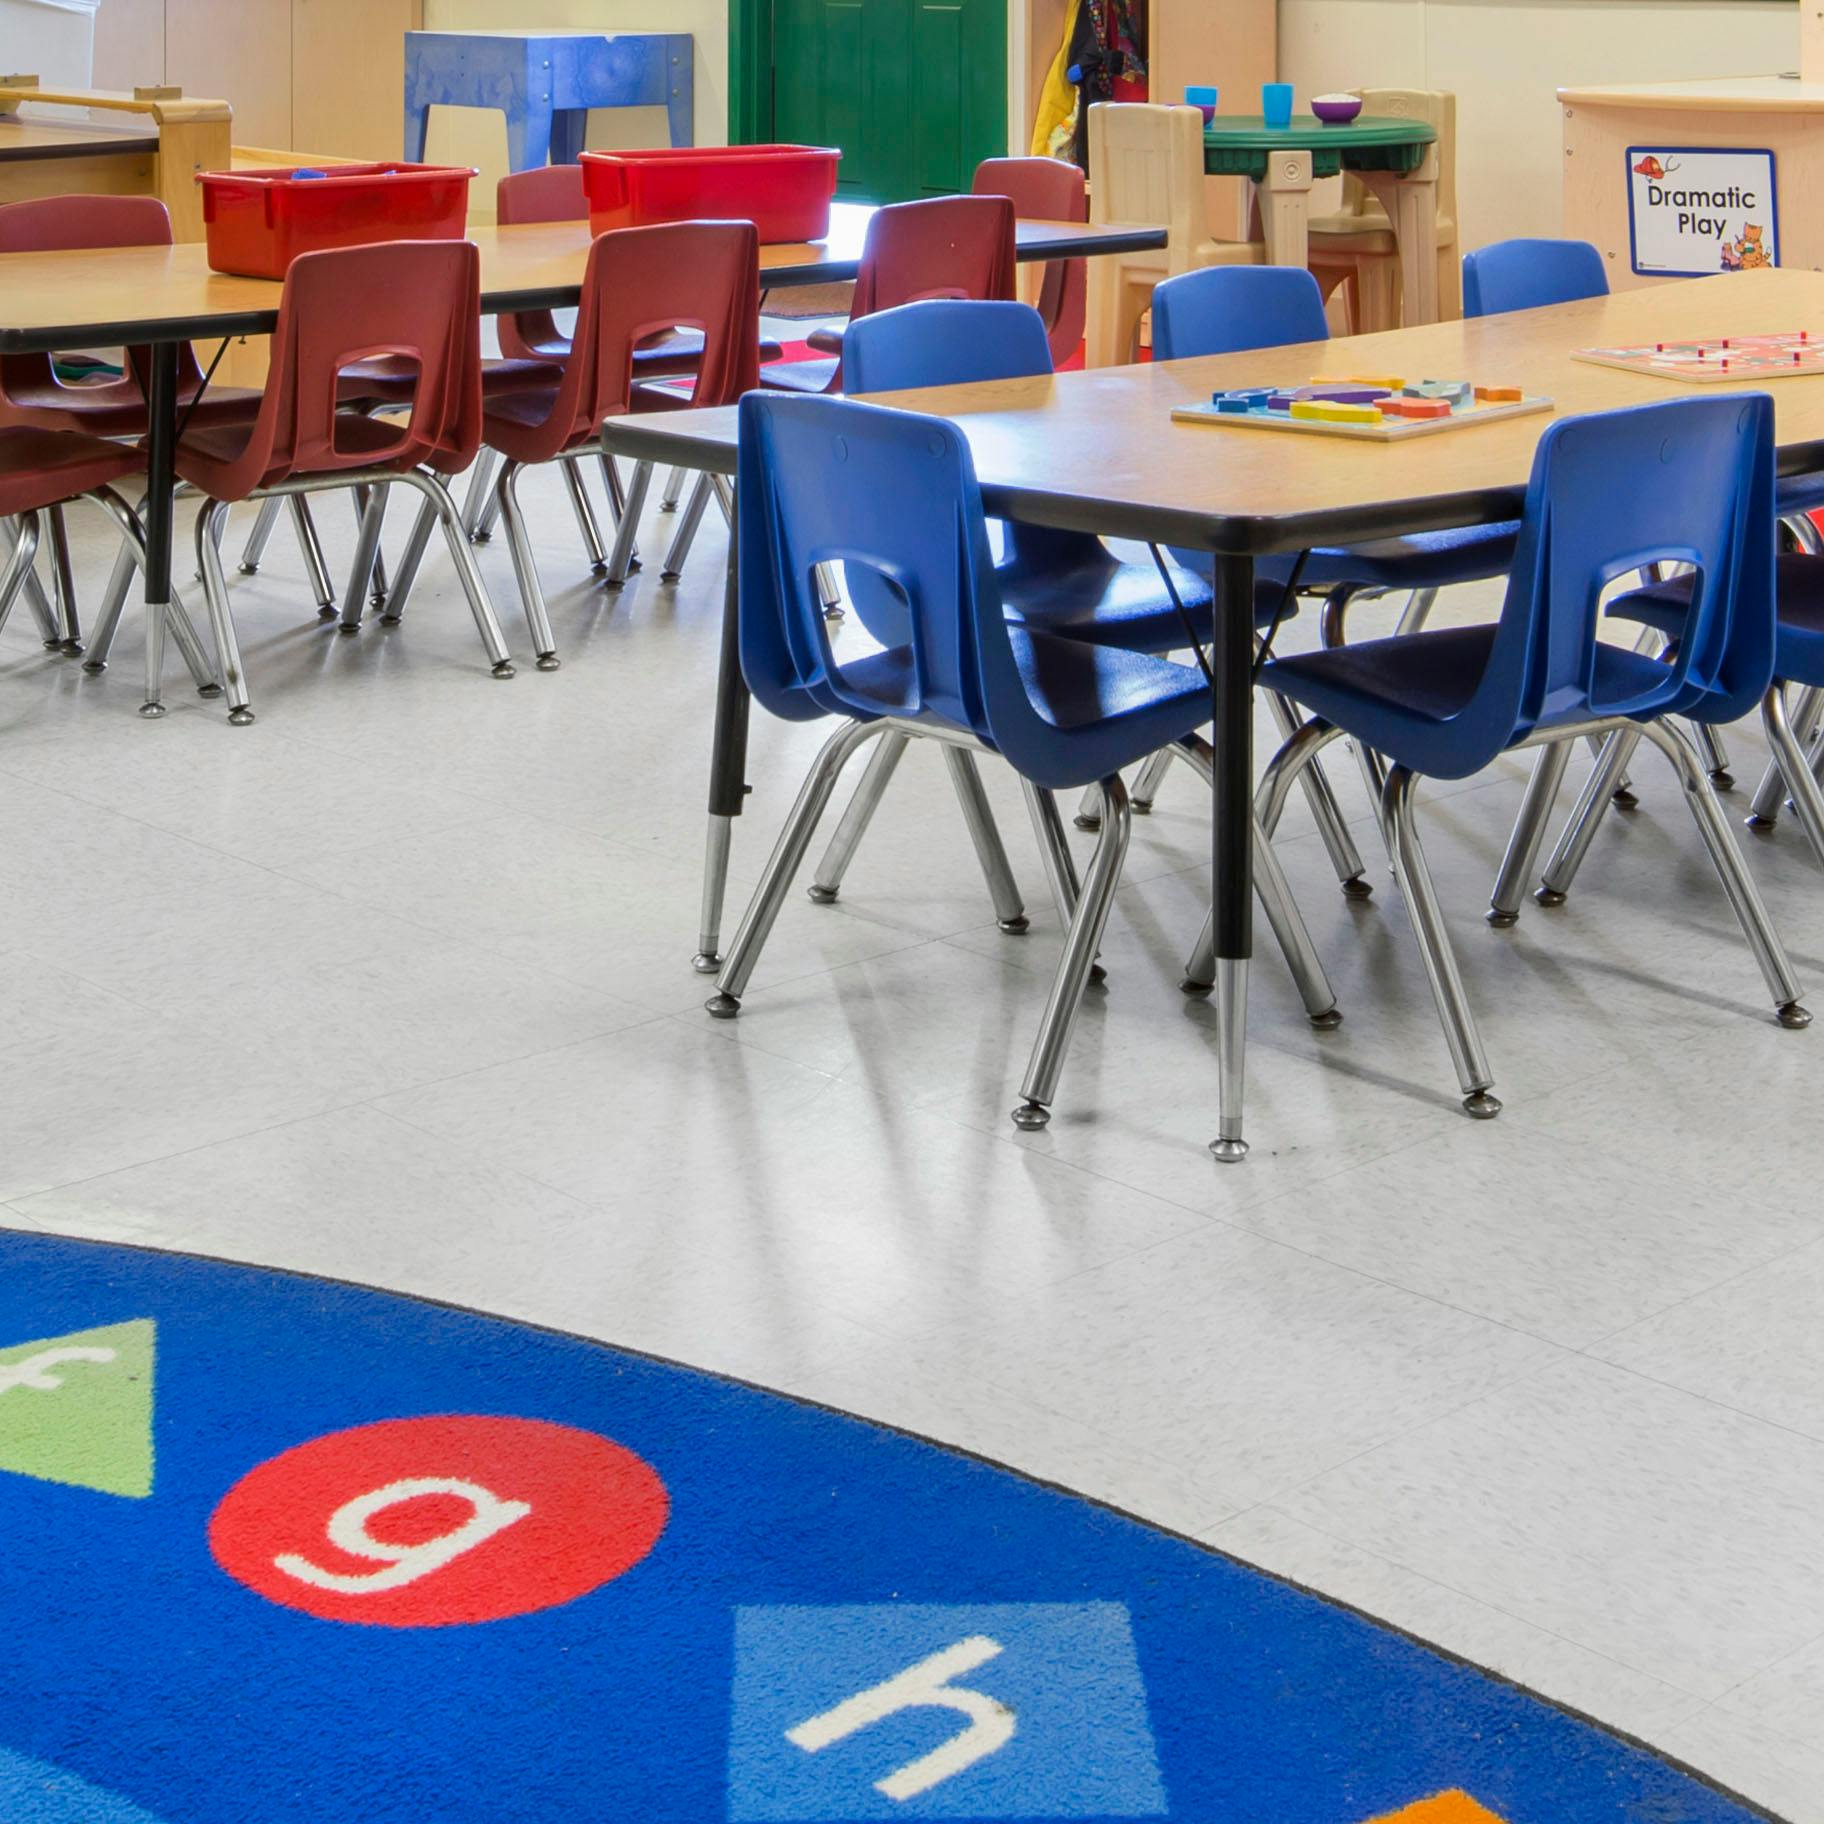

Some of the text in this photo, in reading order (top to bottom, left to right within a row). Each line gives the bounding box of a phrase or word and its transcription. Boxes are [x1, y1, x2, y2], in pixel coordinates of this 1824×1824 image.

[1648, 185, 1756, 209] Dramatic
[1678, 213, 1727, 240] Play
[273, 1476, 532, 1594] g
[784, 1633, 1017, 1802] h
